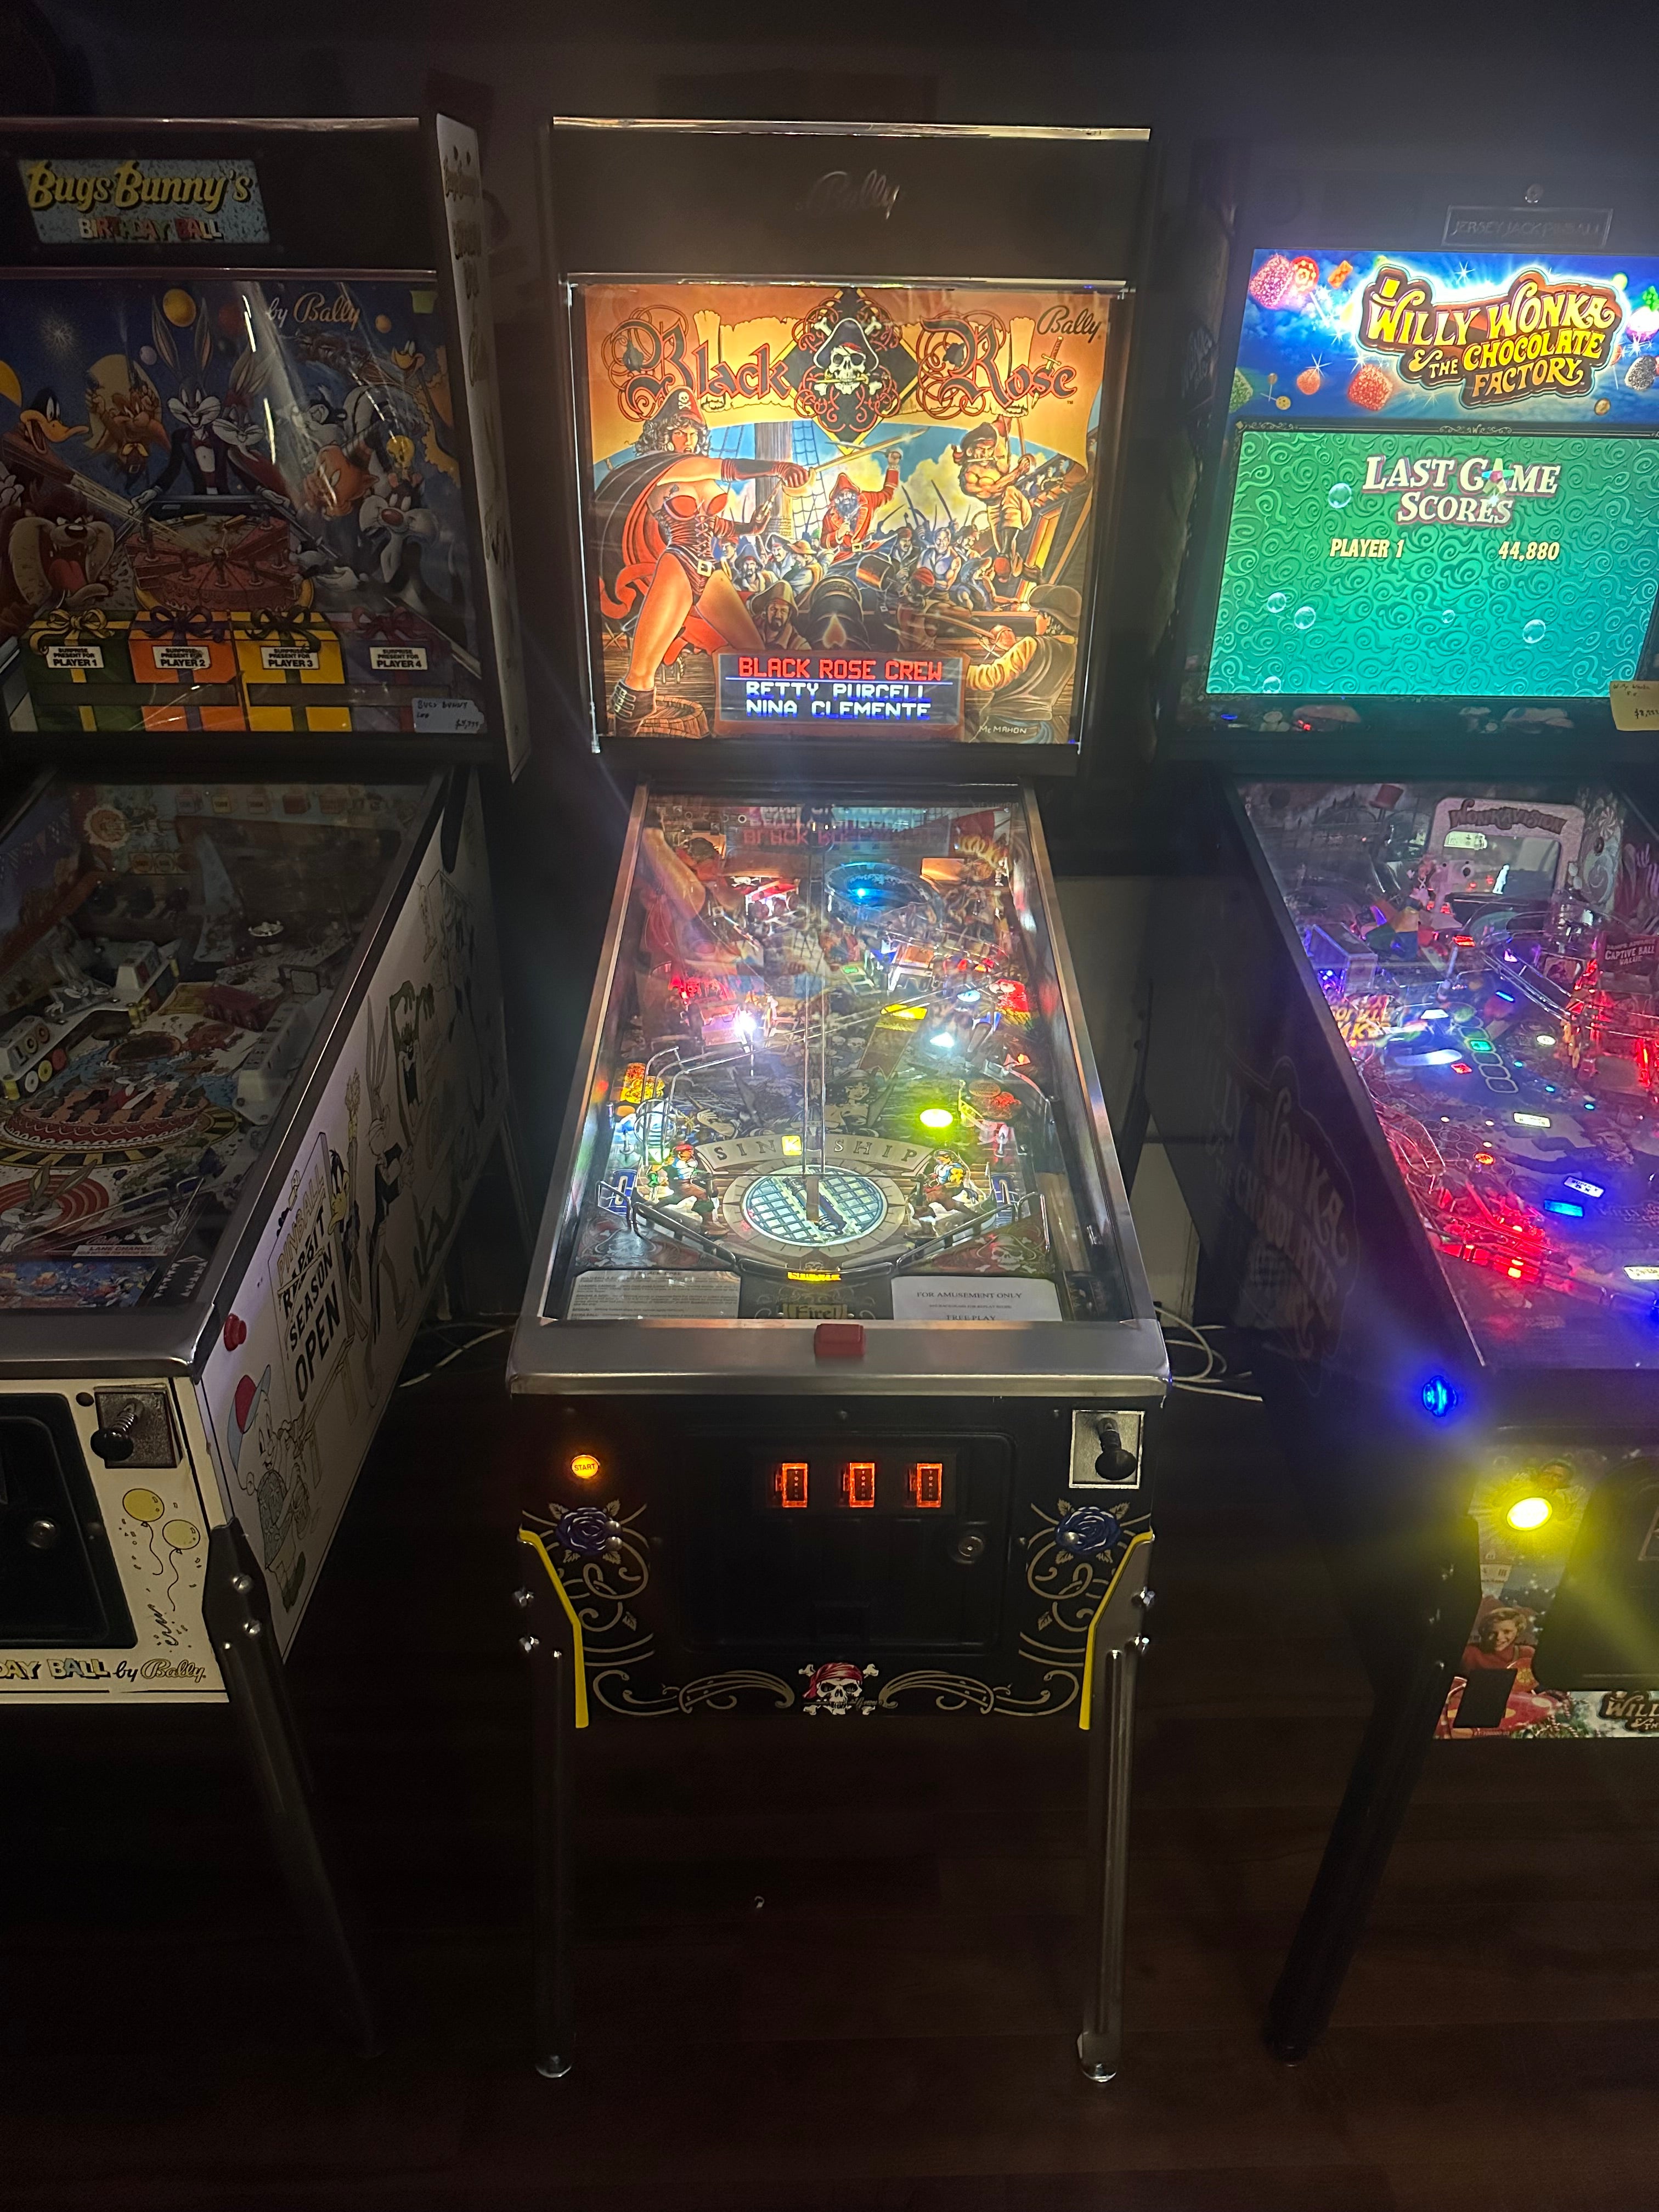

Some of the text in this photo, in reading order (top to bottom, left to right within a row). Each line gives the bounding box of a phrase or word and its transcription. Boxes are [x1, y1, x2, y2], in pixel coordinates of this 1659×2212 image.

[26, 159, 252, 213] Bugs Bunny's
[78, 217, 224, 241] BIRTHDAY BALL
[1451, 221, 1501, 236] JERSEY
[1502, 221, 1543, 237] JACK
[266, 291, 360, 332] by Bally
[1036, 304, 1103, 344] Bally
[1368, 280, 1616, 347] WILLY WONKA
[608, 314, 1077, 415] Black Rose
[1429, 360, 1458, 379] THE
[1462, 327, 1606, 372] CHOCOLATE
[1472, 358, 1585, 398] FACTORY
[1362, 455, 1456, 490] LAST
[1397, 491, 1514, 525] SCORES
[1330, 538, 1404, 558] PLAYER 1
[1498, 540, 1560, 561] 44,880
[53, 658, 91, 667] PLAYER
[160, 659, 198, 667] PLAYER
[268, 659, 306, 668] PLAYER
[377, 660, 415, 669] PLAYER
[738, 657, 943, 681] BLACK ROSE CREW
[746, 681, 932, 702] BETTY PURCELL
[746, 699, 932, 720] NINA CLEMENTE
[1448, 798, 1568, 835] WONKAVISION
[1605, 945, 1655, 960] CAPTIVE BALL
[714, 1138, 918, 1163] SINK SHIP
[295, 1282, 341, 1403] OPEN
[47, 1657, 111, 1679] BALL
[112, 1660, 139, 1683] by
[140, 1658, 206, 1683] Bally
